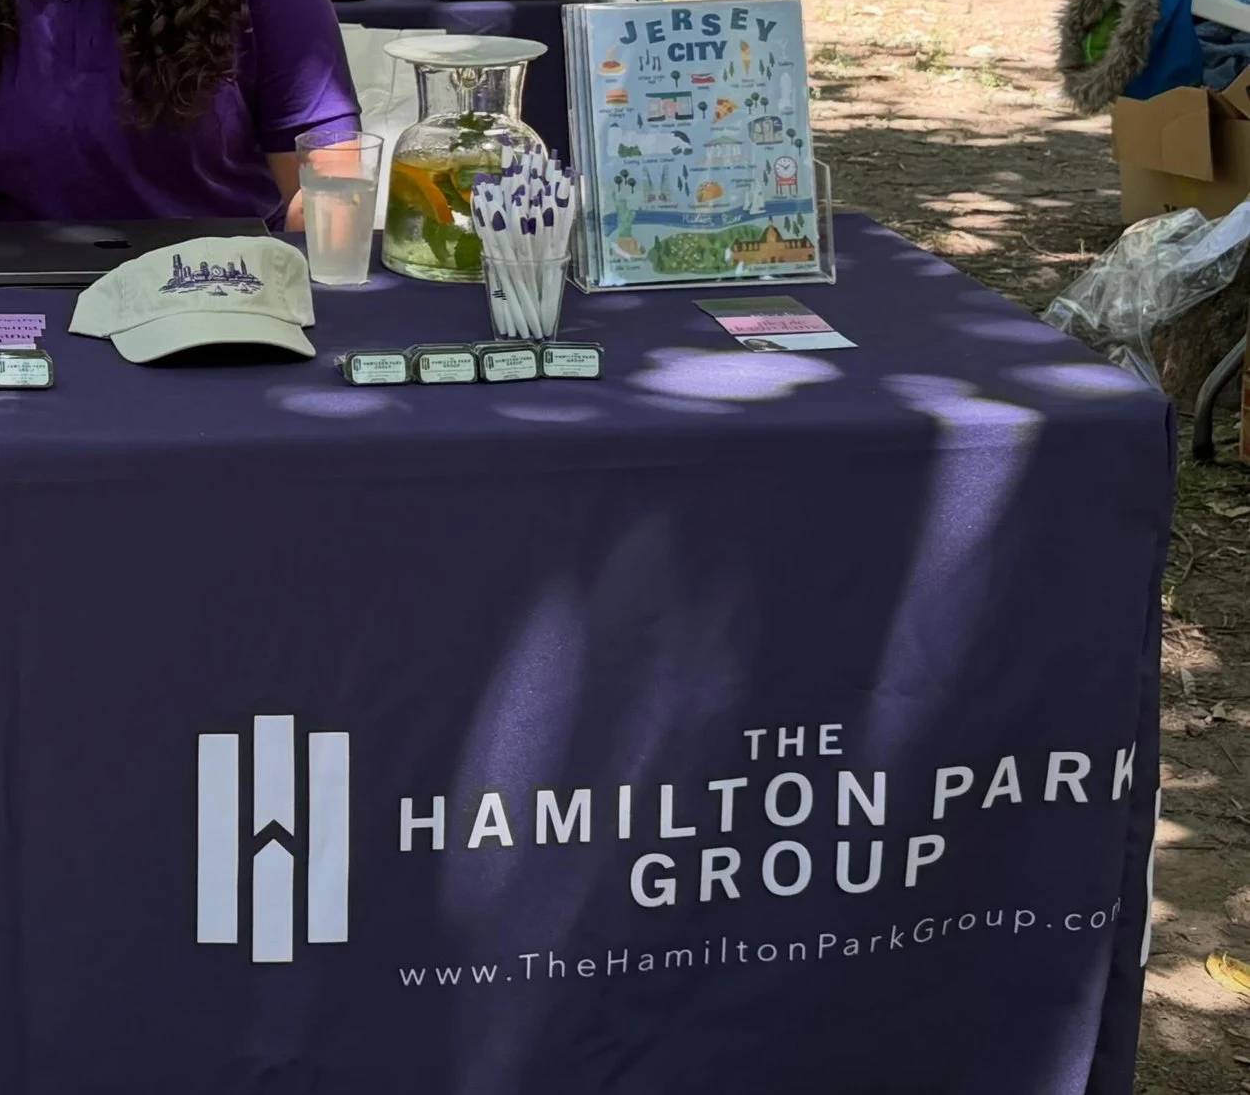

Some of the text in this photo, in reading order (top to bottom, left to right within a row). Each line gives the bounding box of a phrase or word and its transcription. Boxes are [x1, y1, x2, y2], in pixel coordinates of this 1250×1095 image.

[619, 7, 777, 46] JERSEY
[666, 40, 728, 63] CITY
[744, 723, 843, 760] THE
[400, 741, 1137, 852] HAMILTON PARK
[630, 834, 946, 907] GROUP
